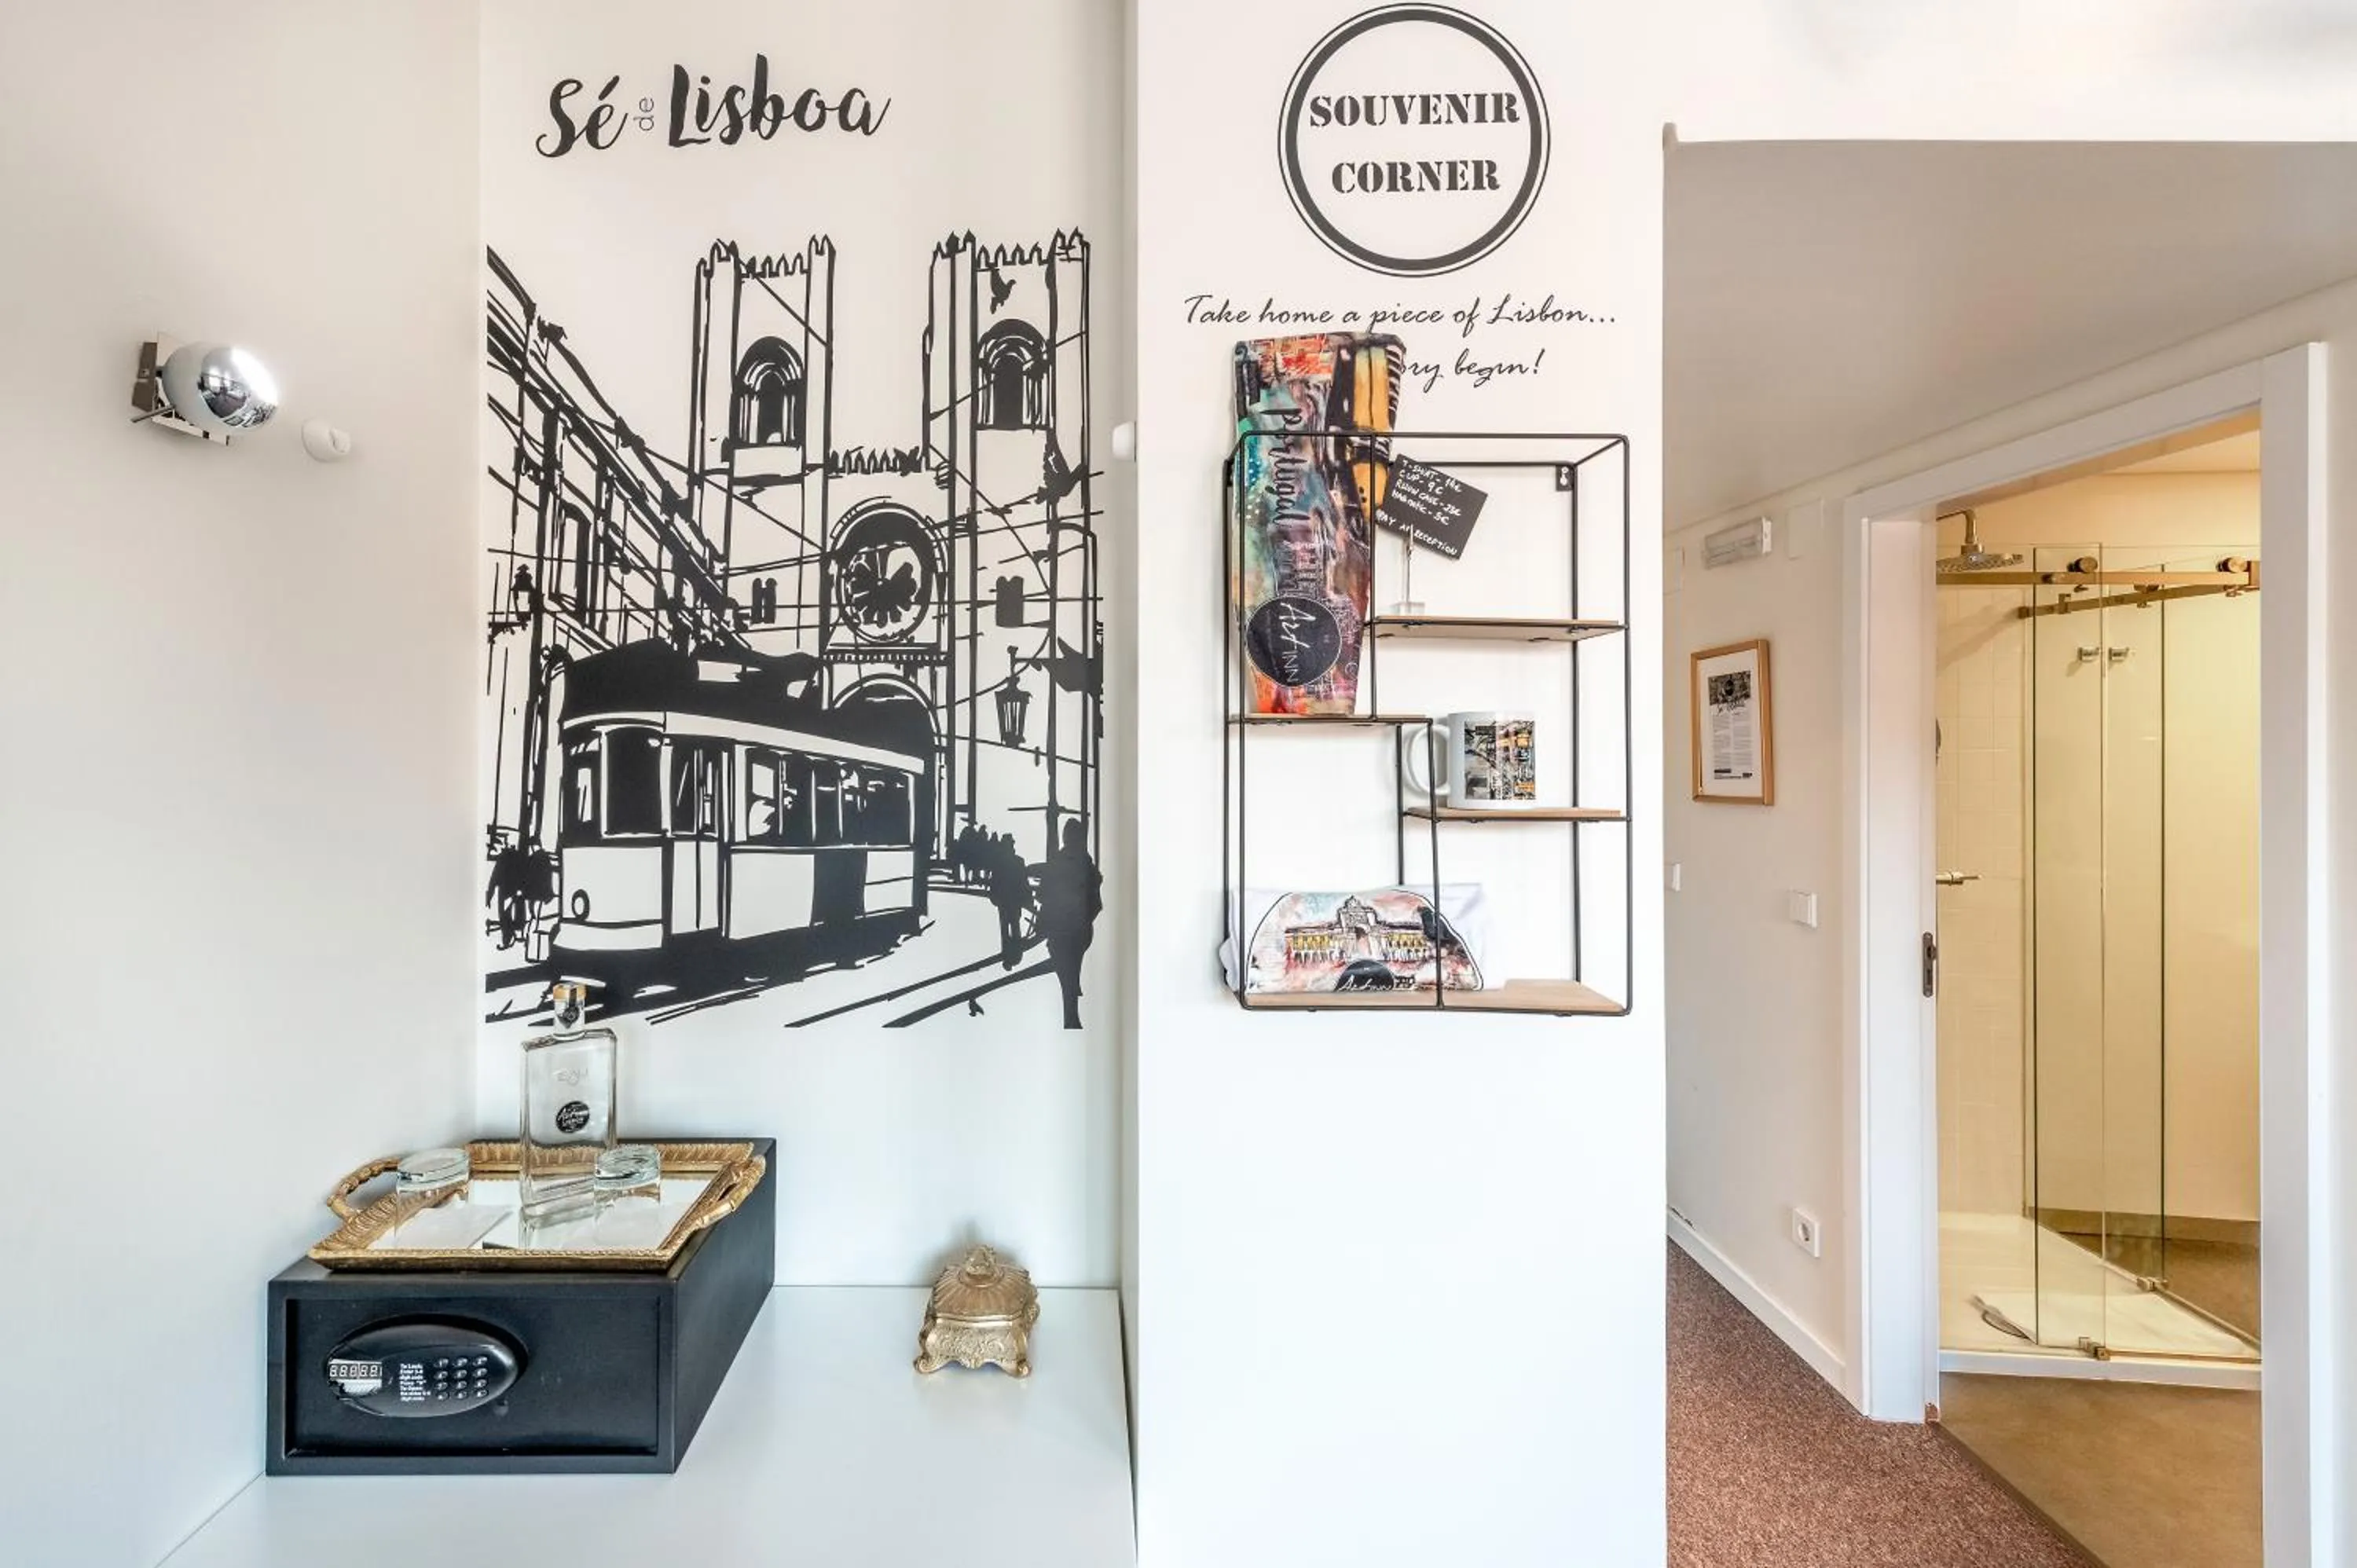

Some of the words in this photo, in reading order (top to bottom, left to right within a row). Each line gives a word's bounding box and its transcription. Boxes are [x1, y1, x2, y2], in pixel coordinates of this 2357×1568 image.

[536, 75, 628, 158] Sé
[633, 97, 654, 131] de
[669, 53, 891, 148] Lisboa
[1310, 92, 1519, 127] SOUVENIR
[1332, 159, 1500, 193] CORNER
[1184, 295, 1251, 323] Take
[1258, 298, 1333, 323] home
[1342, 310, 1361, 323] a
[1365, 302, 1444, 334] piece
[1453, 297, 1481, 338] of
